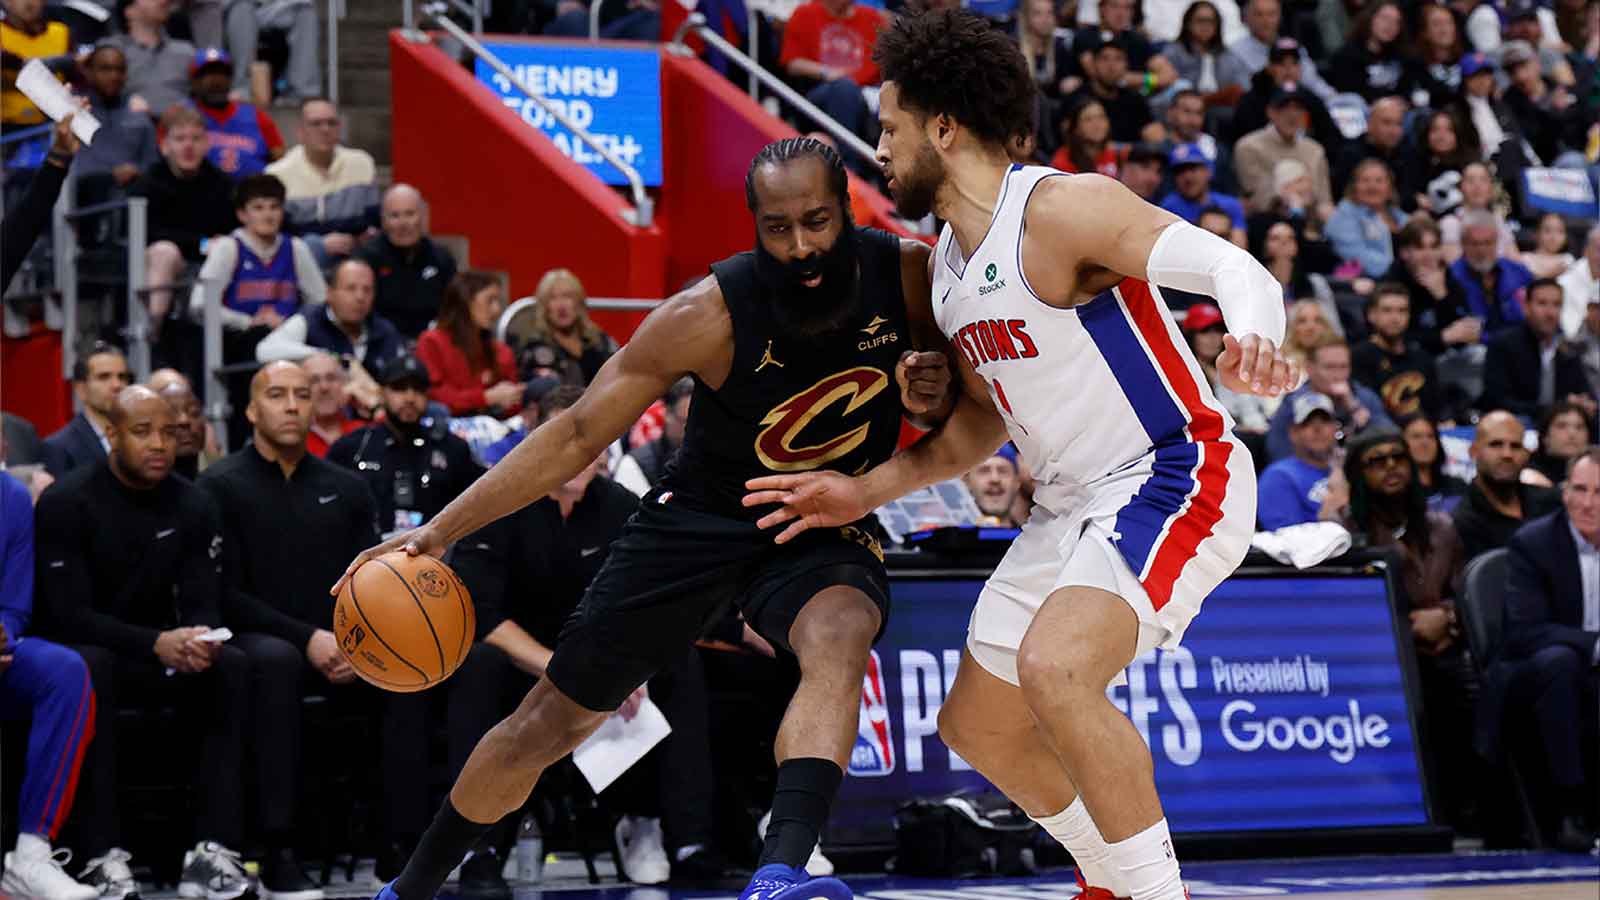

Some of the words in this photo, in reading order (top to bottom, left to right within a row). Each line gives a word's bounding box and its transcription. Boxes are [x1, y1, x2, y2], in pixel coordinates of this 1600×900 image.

[857, 332, 898, 351] CLIFFS
[1211, 655, 1306, 692] Presented
[1304, 653, 1328, 698] by
[1220, 699, 1391, 764] Google
